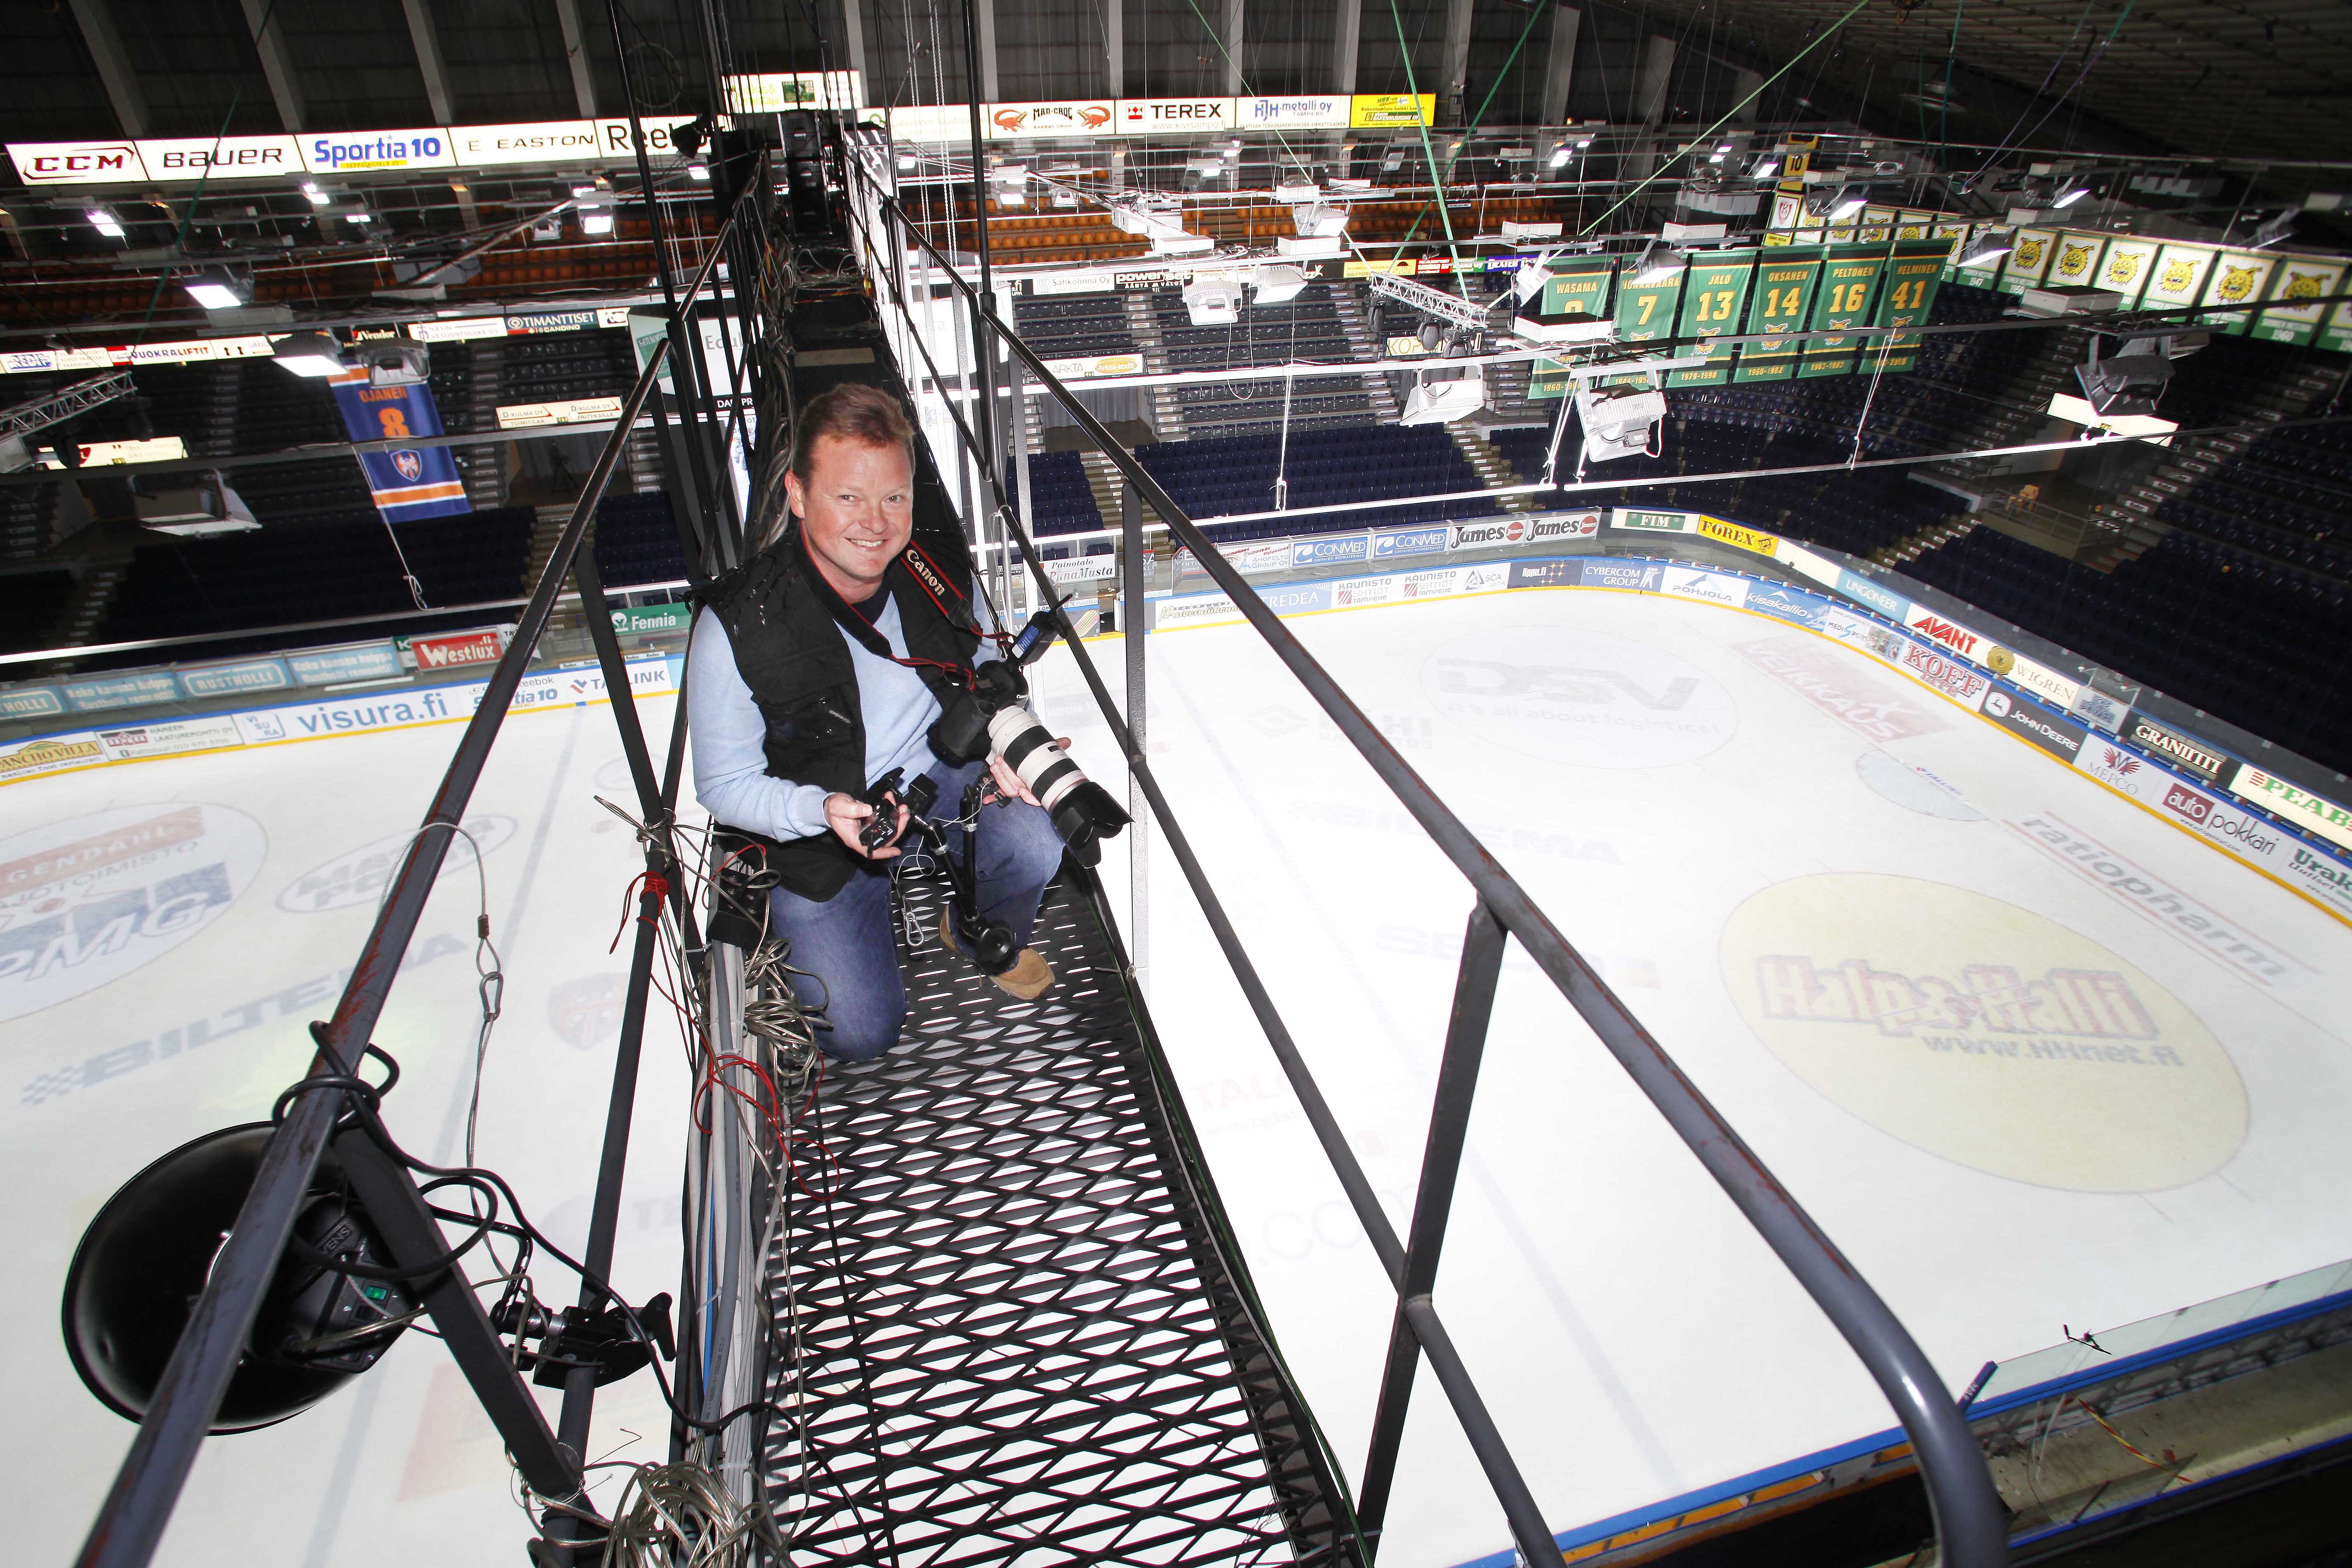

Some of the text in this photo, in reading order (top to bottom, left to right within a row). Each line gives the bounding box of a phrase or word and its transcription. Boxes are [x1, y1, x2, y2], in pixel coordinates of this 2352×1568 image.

[1150, 103, 1221, 119] TEREX
[497, 134, 594, 149] EASTON
[315, 137, 441, 168] Sportia 10
[34, 153, 123, 172] CCM
[1768, 269, 1808, 282] OKSANEN
[1833, 266, 1875, 278] PELTONEN
[1896, 264, 1939, 276] HELMINEN
[1556, 281, 1598, 294] WASAMA
[1708, 274, 1731, 286] JALO
[1764, 287, 1801, 318] 14
[1828, 283, 1867, 314] 16
[1891, 280, 1926, 310] 41
[1637, 295, 1658, 326] 7
[1696, 290, 1735, 322] 13
[523, 312, 595, 326] TIMANTTISET
[131, 347, 210, 359] VUOKRALIFTIT
[1052, 363, 1084, 375] ARKTA
[358, 386, 409, 403] OJANEN
[378, 407, 405, 438] 8
[1526, 519, 1580, 541] James
[1639, 514, 1671, 528] FIM
[1450, 525, 1505, 549] James
[1701, 521, 1755, 545] FOREX
[906, 549, 945, 596] Canon
[1052, 558, 1094, 569] Painotalo
[1522, 566, 1547, 577] lippu.fi
[1585, 566, 1641, 578] CYBERCOM
[1050, 567, 1113, 581] PunaMusta
[1405, 571, 1457, 583] KAUNISTO
[1485, 573, 1502, 583] SCA
[1603, 576, 1638, 587] GROUP
[1338, 577, 1392, 591] KAUNISTO
[1418, 588, 1451, 596] TAMPERE
[1672, 585, 1733, 602] POHJOLA
[1353, 595, 1387, 603] TAMPERE
[1746, 592, 1808, 618] kisakallio
[1846, 579, 1897, 612] LINGONEER
[631, 612, 676, 630] Fennia
[1828, 621, 1844, 632] MEDI
[480, 635, 492, 644] .fi
[1912, 616, 1978, 654] AVANT
[420, 644, 495, 667] Westlux
[1903, 642, 1985, 697] KOFF
[197, 671, 274, 691] RUSTHOLLI
[1436, 658, 1700, 712] DSV
[2016, 664, 2075, 700] WIGREN
[538, 688, 558, 701] 10
[1743, 641, 1903, 742] VEIKKAUS
[0, 698, 48, 713] HOLLI
[298, 692, 448, 733] visura.fi
[1494, 706, 1520, 719] all
[1525, 707, 1597, 725] about
[2010, 710, 2079, 752] JOHN DEERE
[54, 744, 99, 758] VILLA
[2135, 725, 2223, 774] GRANIITTI
[2086, 762, 2138, 795] MEPCO
[2167, 790, 2206, 819] auto
[2260, 773, 2352, 828] PEAB
[2208, 813, 2280, 856] pokkari
[2023, 816, 2290, 980] ratiopharm
